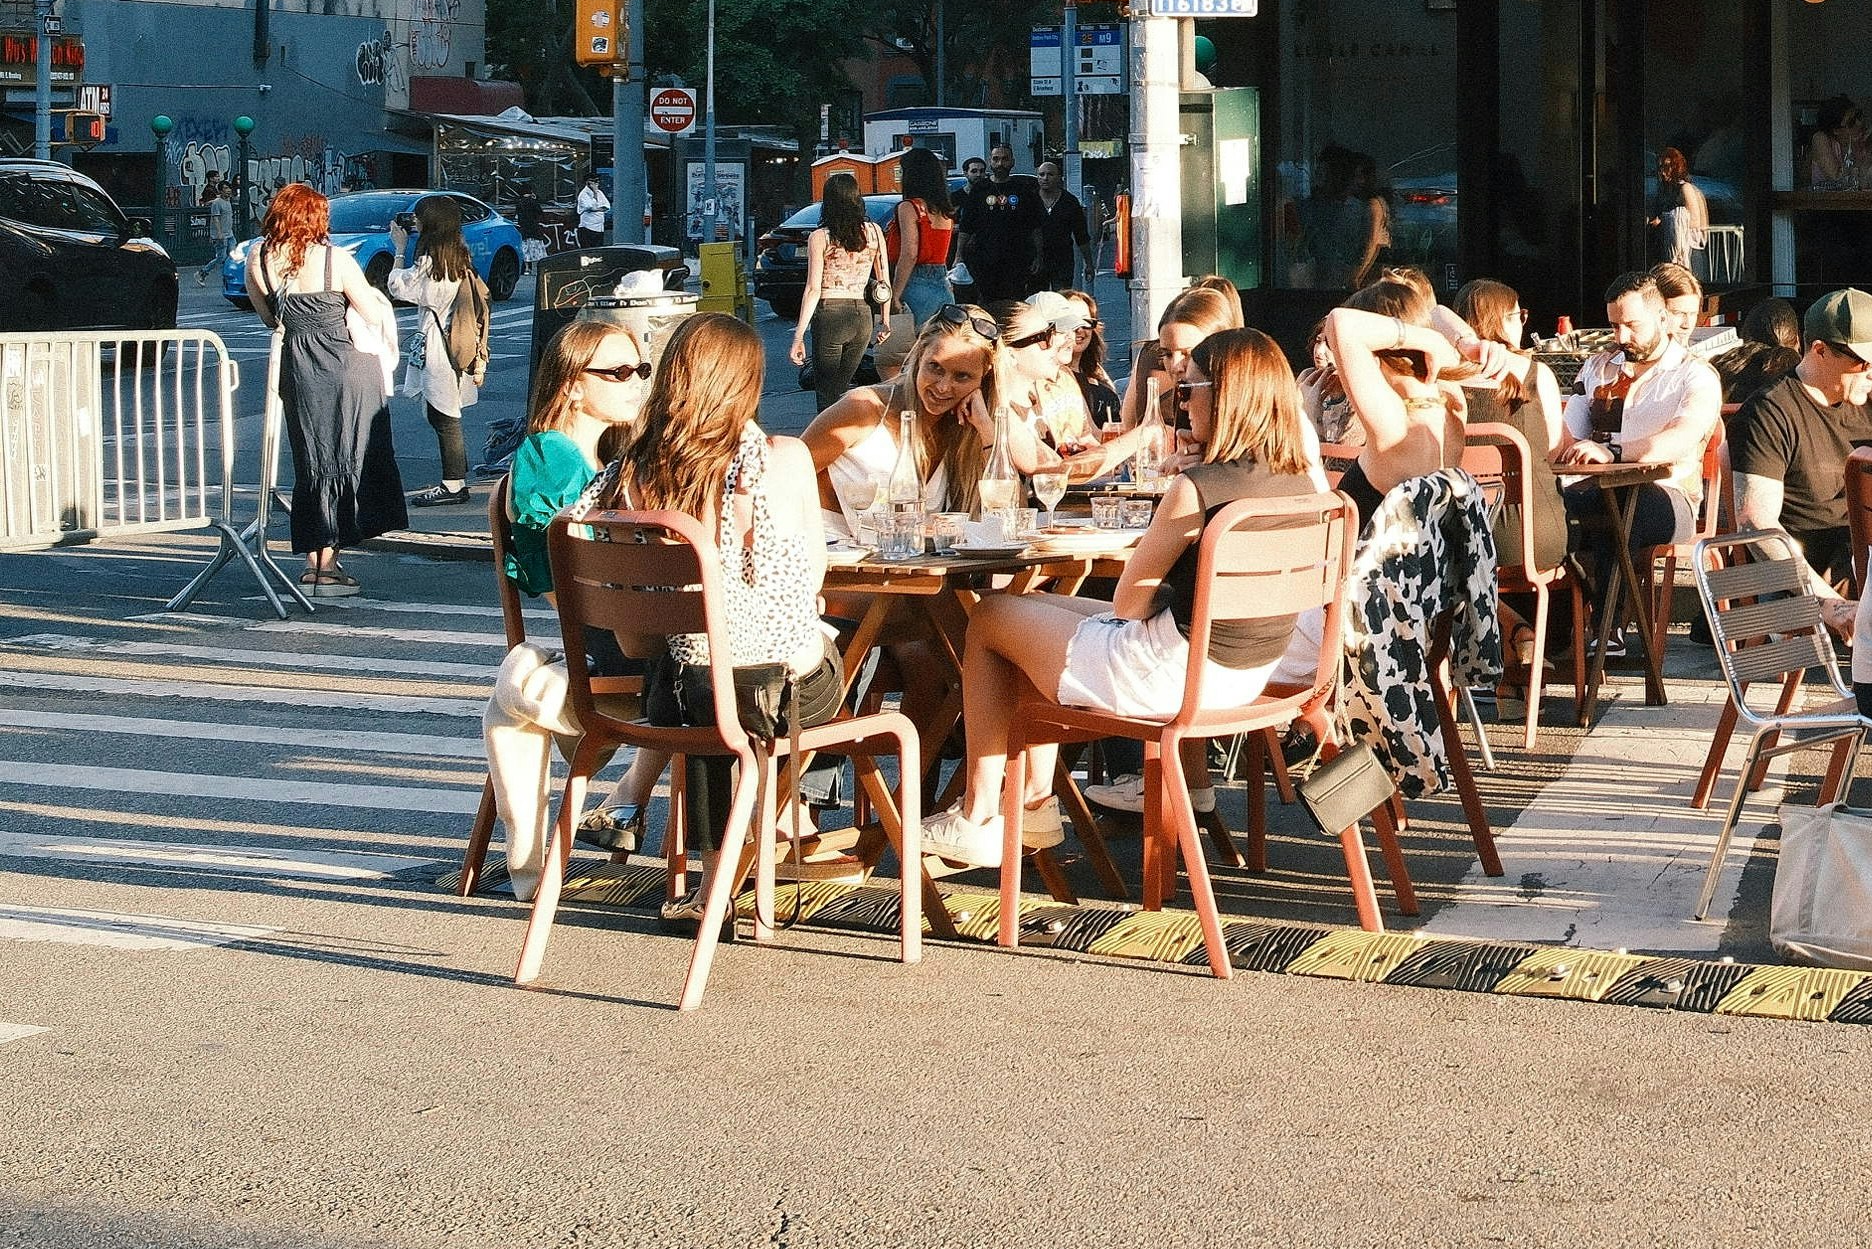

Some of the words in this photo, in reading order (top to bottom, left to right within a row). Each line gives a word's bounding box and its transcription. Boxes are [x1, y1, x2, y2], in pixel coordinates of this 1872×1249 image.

[1099, 32, 1112, 43] M9
[80, 86, 100, 113] ATM
[658, 97, 670, 105] DO
[672, 97, 688, 105] NOT
[660, 116, 685, 124] ENTER
